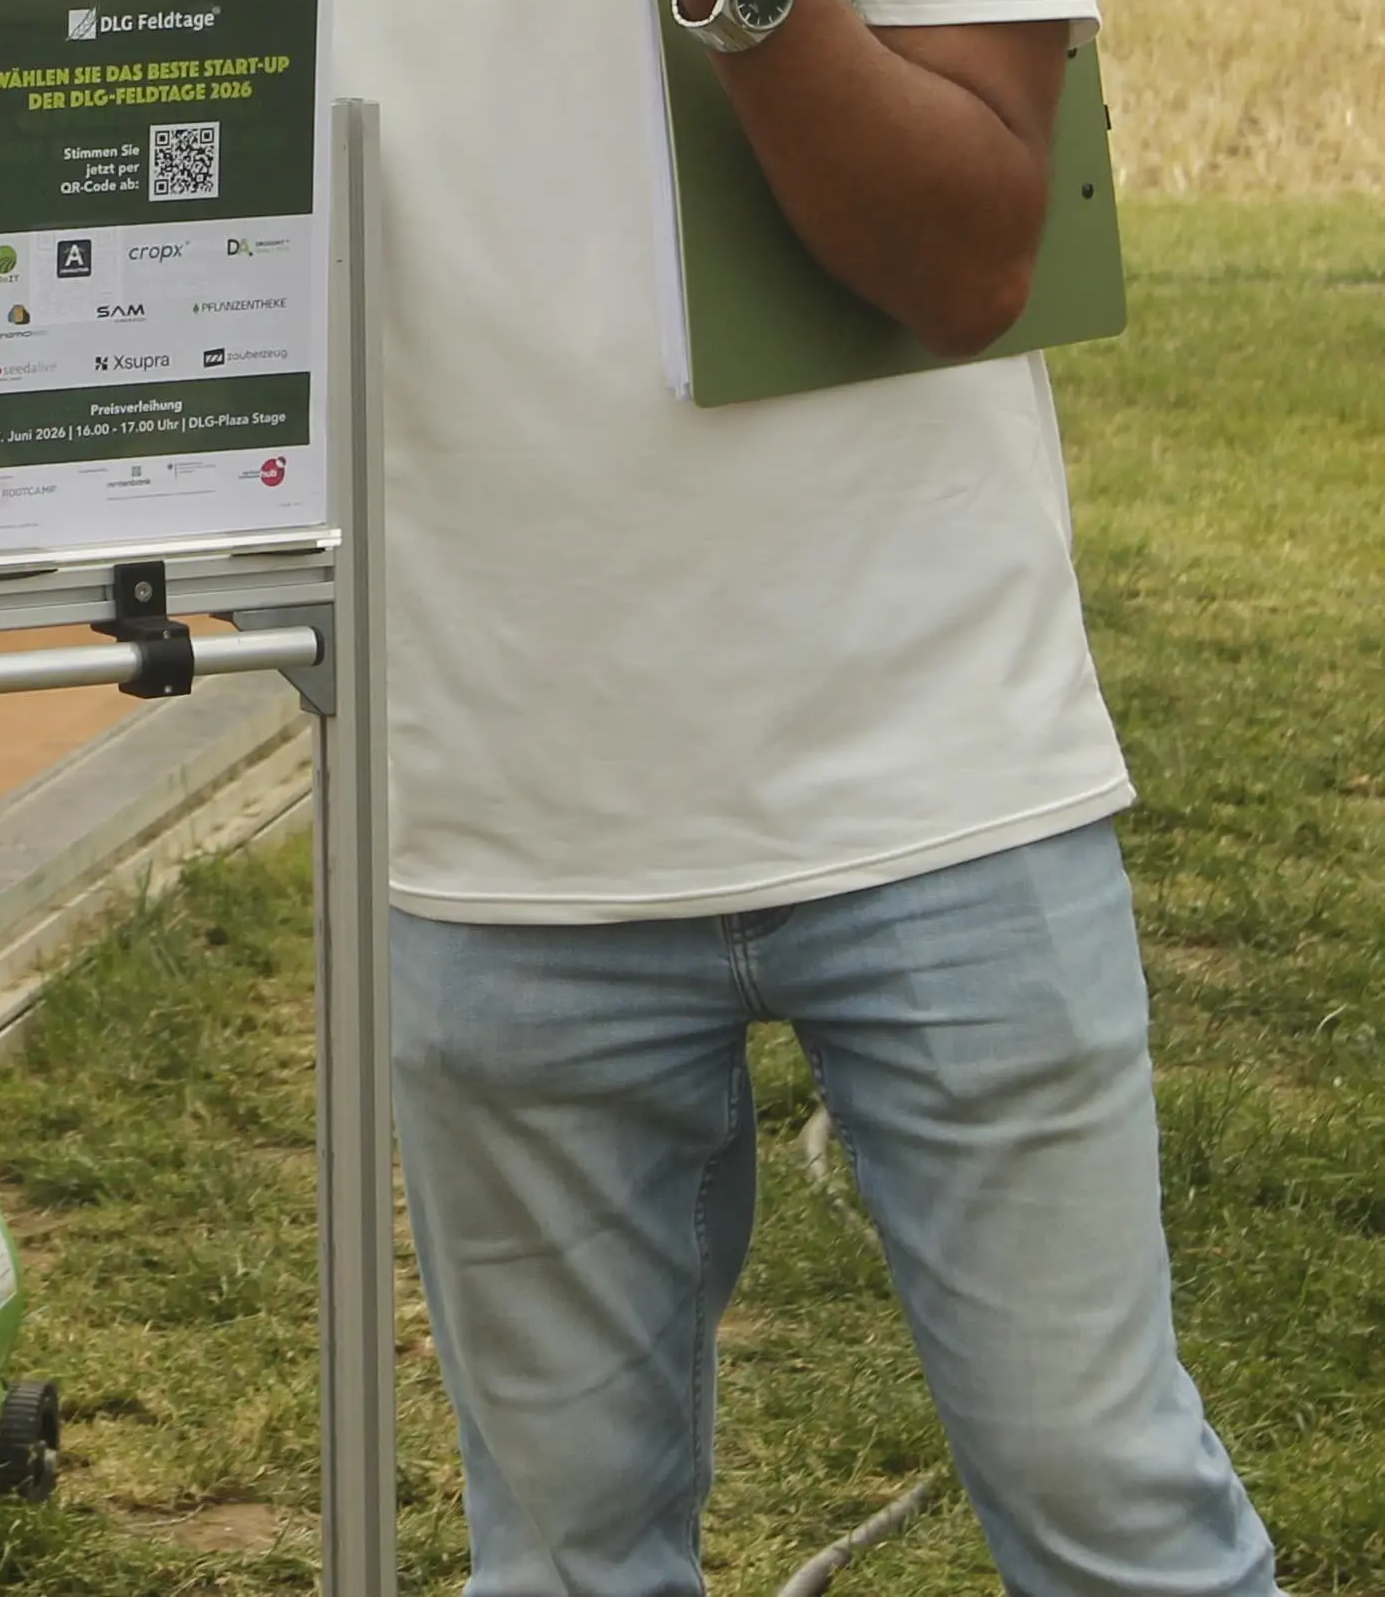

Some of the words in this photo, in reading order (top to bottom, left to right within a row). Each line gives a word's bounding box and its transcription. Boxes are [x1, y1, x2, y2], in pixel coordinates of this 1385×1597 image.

[100, 14, 133, 33] DLG
[138, 10, 215, 31] Feldtage
[74, 65, 101, 85] SIE
[106, 62, 143, 82] DAS
[147, 60, 200, 80] BESTE
[203, 56, 290, 78] START-UP
[28, 91, 66, 110] DER
[70, 83, 206, 109] DLG-FELDTAGE
[210, 80, 252, 100] 2026
[63, 144, 118, 161] Stimmen
[121, 144, 140, 158] Sie
[86, 163, 115, 179] jetzt
[118, 164, 140, 178] per
[60, 179, 117, 194] QR-Code
[119, 178, 140, 192] ab:
[128, 244, 183, 264] cropx
[113, 353, 170, 371] Xsupra
[90, 400, 182, 417] Preisverleihung
[8, 428, 32, 442] Juni
[36, 426, 66, 440] 2026
[77, 424, 109, 437] 16.00
[121, 420, 154, 434] 17.00
[158, 417, 179, 431] Uhr
[189, 413, 249, 428] DLG-Plaza
[252, 411, 286, 426] Stage
